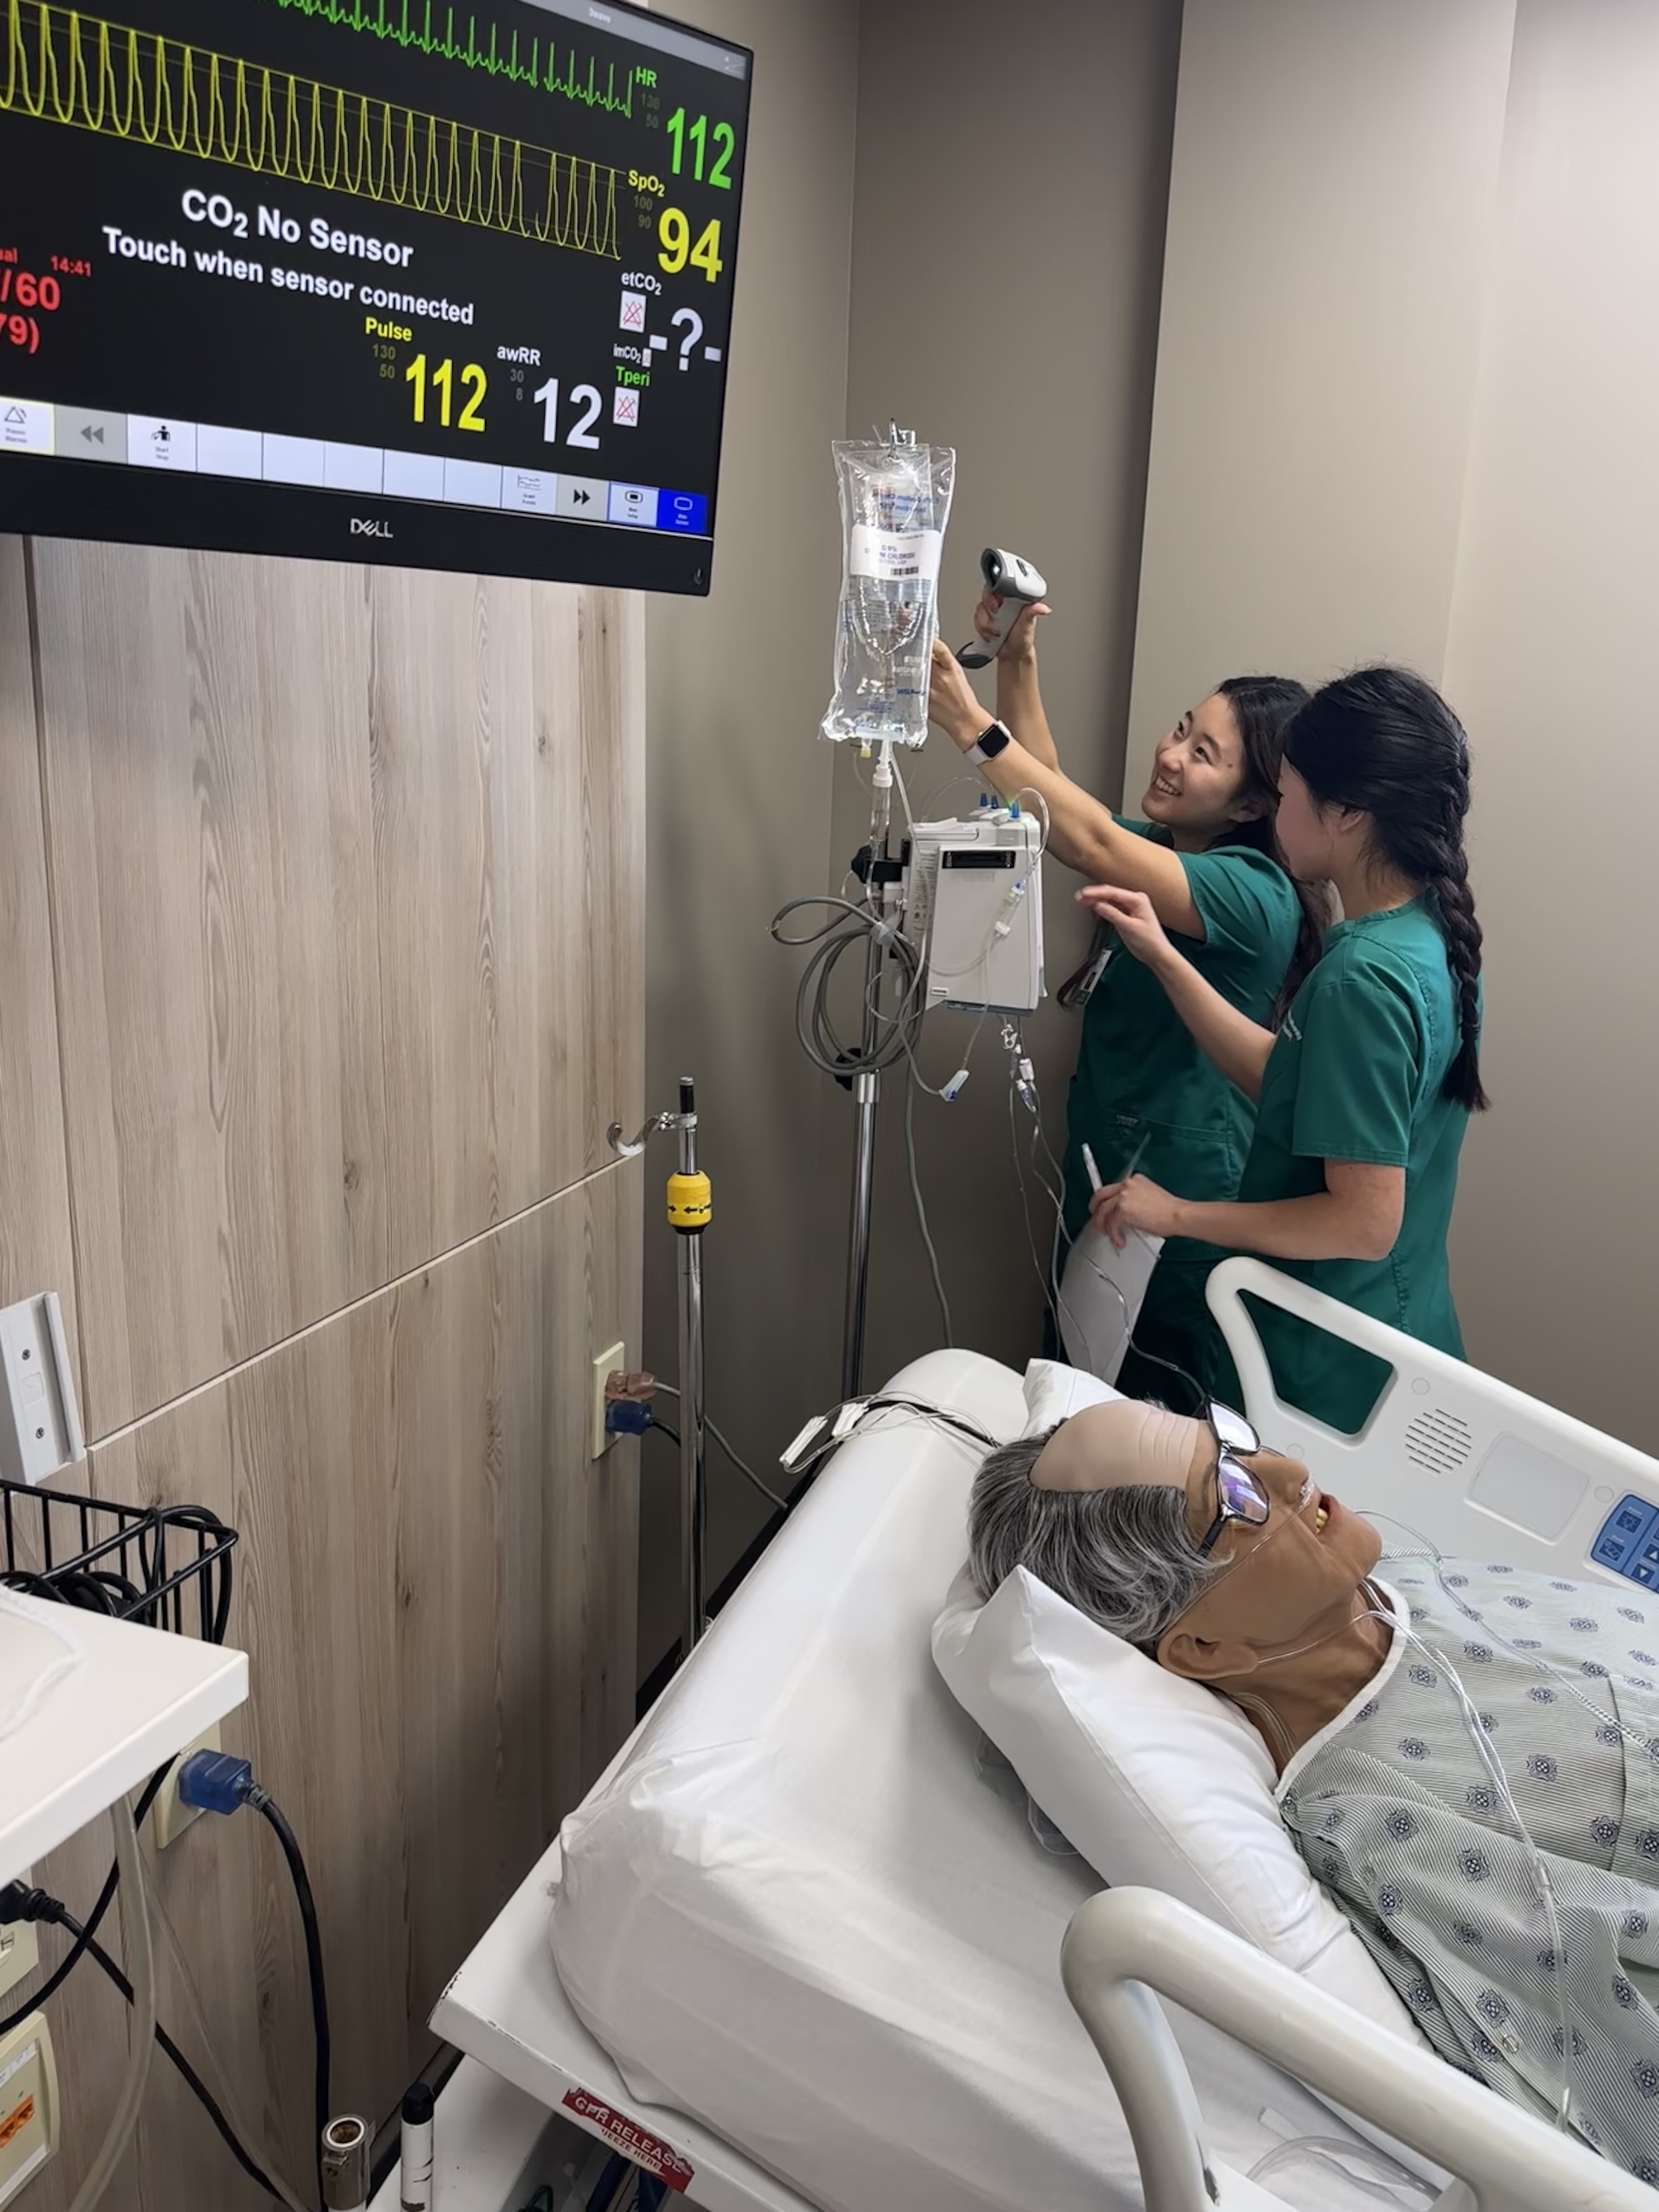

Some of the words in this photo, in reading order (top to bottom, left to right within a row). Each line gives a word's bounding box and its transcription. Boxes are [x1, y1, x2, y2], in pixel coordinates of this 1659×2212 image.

[636, 66, 657, 88] HR
[641, 93, 660, 110] 130
[645, 114, 659, 129] 50
[667, 107, 735, 189] 112
[634, 195, 653, 211] 100
[638, 214, 652, 229] 90
[258, 205, 301, 243] No
[309, 218, 414, 267] Sensor
[658, 207, 723, 283] 94
[50, 255, 91, 278] 14:41
[103, 225, 187, 267] Touch
[194, 250, 263, 283] when
[271, 267, 354, 300] sensor
[360, 286, 474, 325] connected
[365, 317, 413, 342] Pulse
[372, 343, 397, 360] 130
[497, 345, 541, 366] awRR
[380, 364, 396, 379] 50
[510, 368, 524, 383] 30
[616, 365, 651, 386] Tperi
[405, 354, 487, 432] 112
[516, 387, 523, 401] 8
[533, 377, 602, 450] 12
[351, 518, 394, 538] DELL
